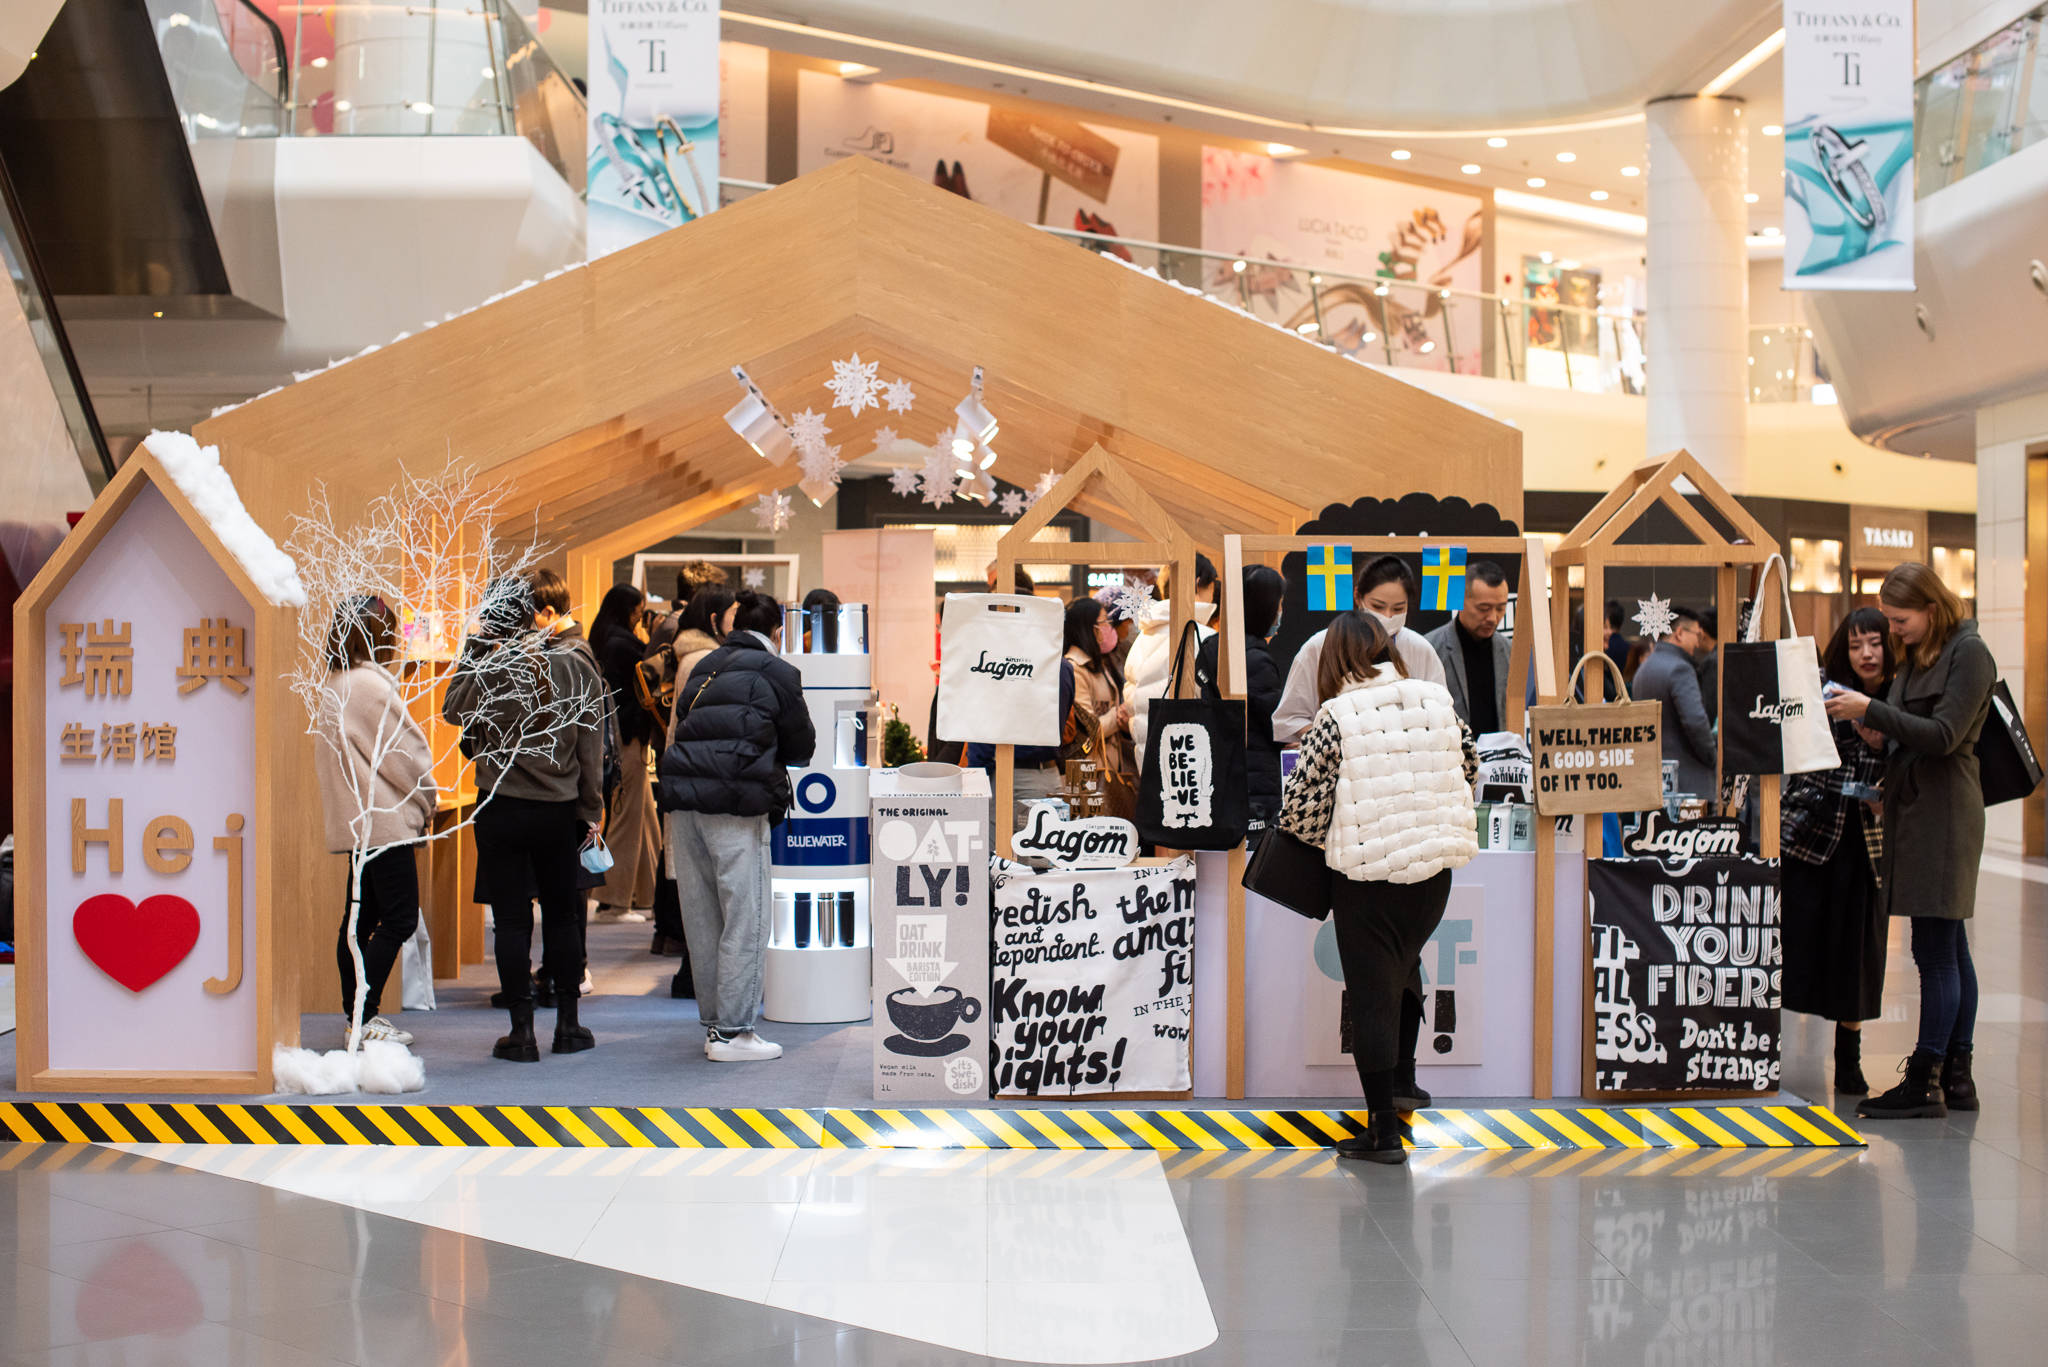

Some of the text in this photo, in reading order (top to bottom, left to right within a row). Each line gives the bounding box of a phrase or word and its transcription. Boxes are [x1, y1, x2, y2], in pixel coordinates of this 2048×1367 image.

[1863, 527, 1914, 548] TASAKI
[59, 618, 252, 696] 瑞典
[970, 650, 1034, 680] Lagom
[1749, 694, 1803, 724] Lagom
[60, 721, 178, 762] 生活馆
[1170, 734, 1195, 751] WE
[1169, 752, 1196, 770] BE-
[1540, 748, 1635, 769] A GOOD SIDE
[1171, 770, 1197, 787] LIE
[1490, 773, 1528, 785] ORDINARY
[1492, 765, 1526, 774] QUITE
[1540, 772, 1622, 792] OF IT TOO.
[1170, 787, 1199, 806] -VE
[878, 808, 948, 817] THE ORIGINAL
[787, 835, 847, 848] BLUEWATER
[878, 820, 984, 863] OAT-
[1020, 810, 1127, 862] Lagom
[1631, 811, 1741, 861] Lagom
[71, 797, 245, 995] Hej
[896, 864, 970, 907] LY!
[900, 924, 927, 941] OAT
[1004, 926, 1044, 946] and
[900, 941, 942, 958] DRINK
[1660, 925, 1782, 967] YOUR
[906, 962, 941, 972] BARISTA
[908, 972, 941, 982] EDITION
[992, 977, 1107, 1028] Know
[1134, 1004, 1149, 1017] IN
[1153, 996, 1184, 1011] THE
[1014, 1015, 1107, 1060] your
[1680, 1017, 1736, 1050] Don't
[1741, 1021, 1771, 1052] be
[951, 1066, 977, 1079] Swe-
[1686, 1050, 1781, 1091] strange
[952, 1077, 977, 1090] dish!
